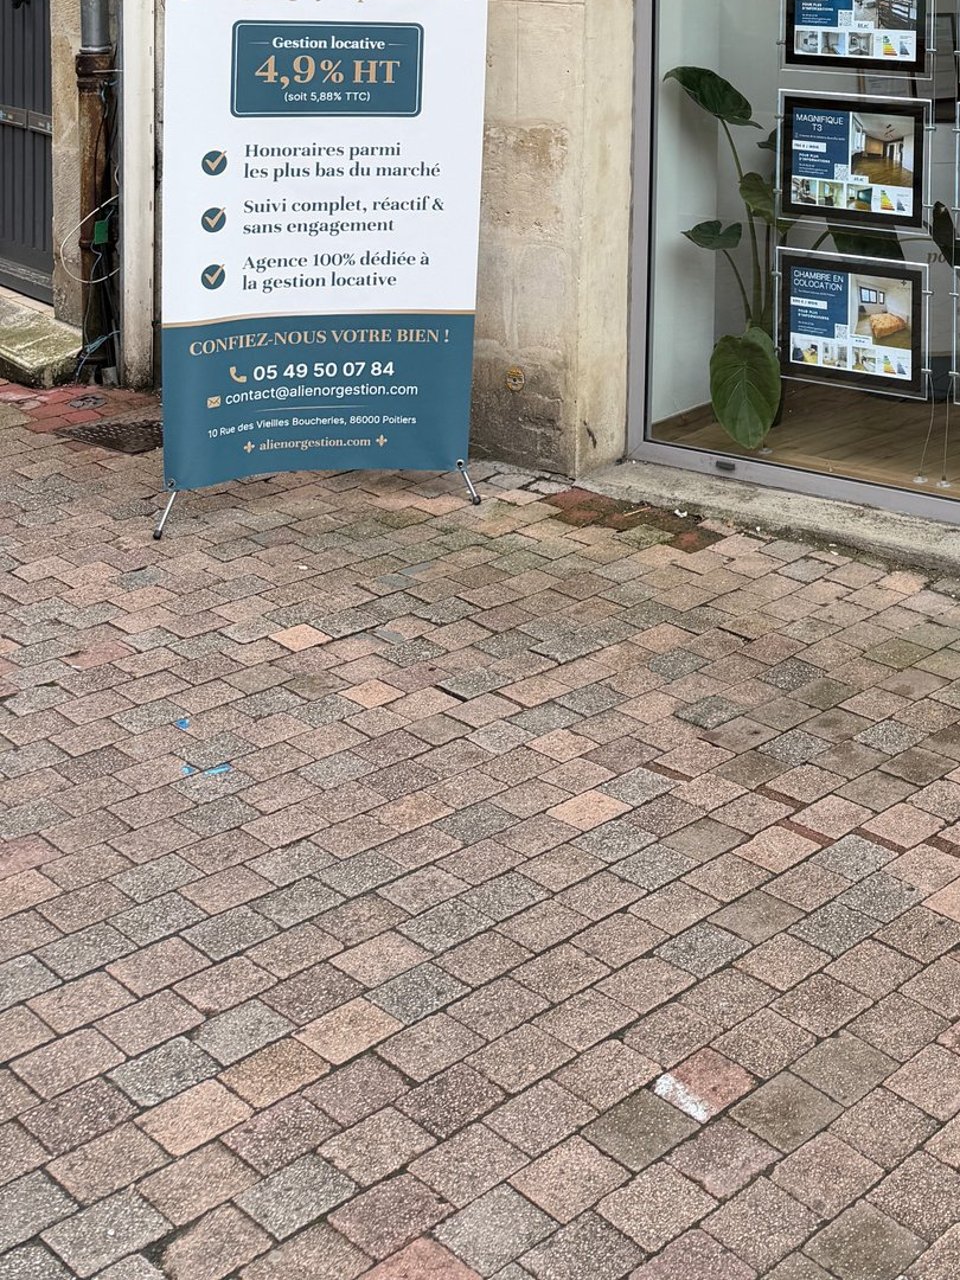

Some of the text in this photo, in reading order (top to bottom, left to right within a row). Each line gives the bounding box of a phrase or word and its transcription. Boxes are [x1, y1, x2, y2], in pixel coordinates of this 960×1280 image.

[272, 36, 386, 51] Gestion locative
[254, 55, 400, 89] 4,9% HT
[284, 91, 371, 104] (soit 5,88% TTC)
[795, 113, 844, 126] MAGNIFIQUE
[812, 123, 823, 133] T3
[244, 141, 401, 161] Honoraires parmi
[243, 161, 441, 182] les plus bas du marché
[243, 196, 445, 216] Suivi complet, réactif &
[242, 219, 395, 237] sans engagement
[242, 250, 430, 274] Agence 100% dédiée à
[242, 272, 397, 294] la gestion locative
[793, 269, 844, 283] CHAMBRE EN
[793, 278, 843, 292] COLOCATION
[189, 328, 450, 357] CONFIEZ-NOUS VOTRE BIEN !
[253, 361, 395, 381] 05 49 50 07 84
[225, 384, 419, 405] contact@alienorgestion.com
[208, 415, 417, 439] 10 Rue des Vieilles Boucheries, 86000 Poitiers
[259, 436, 372, 453] alienorgestion.com
